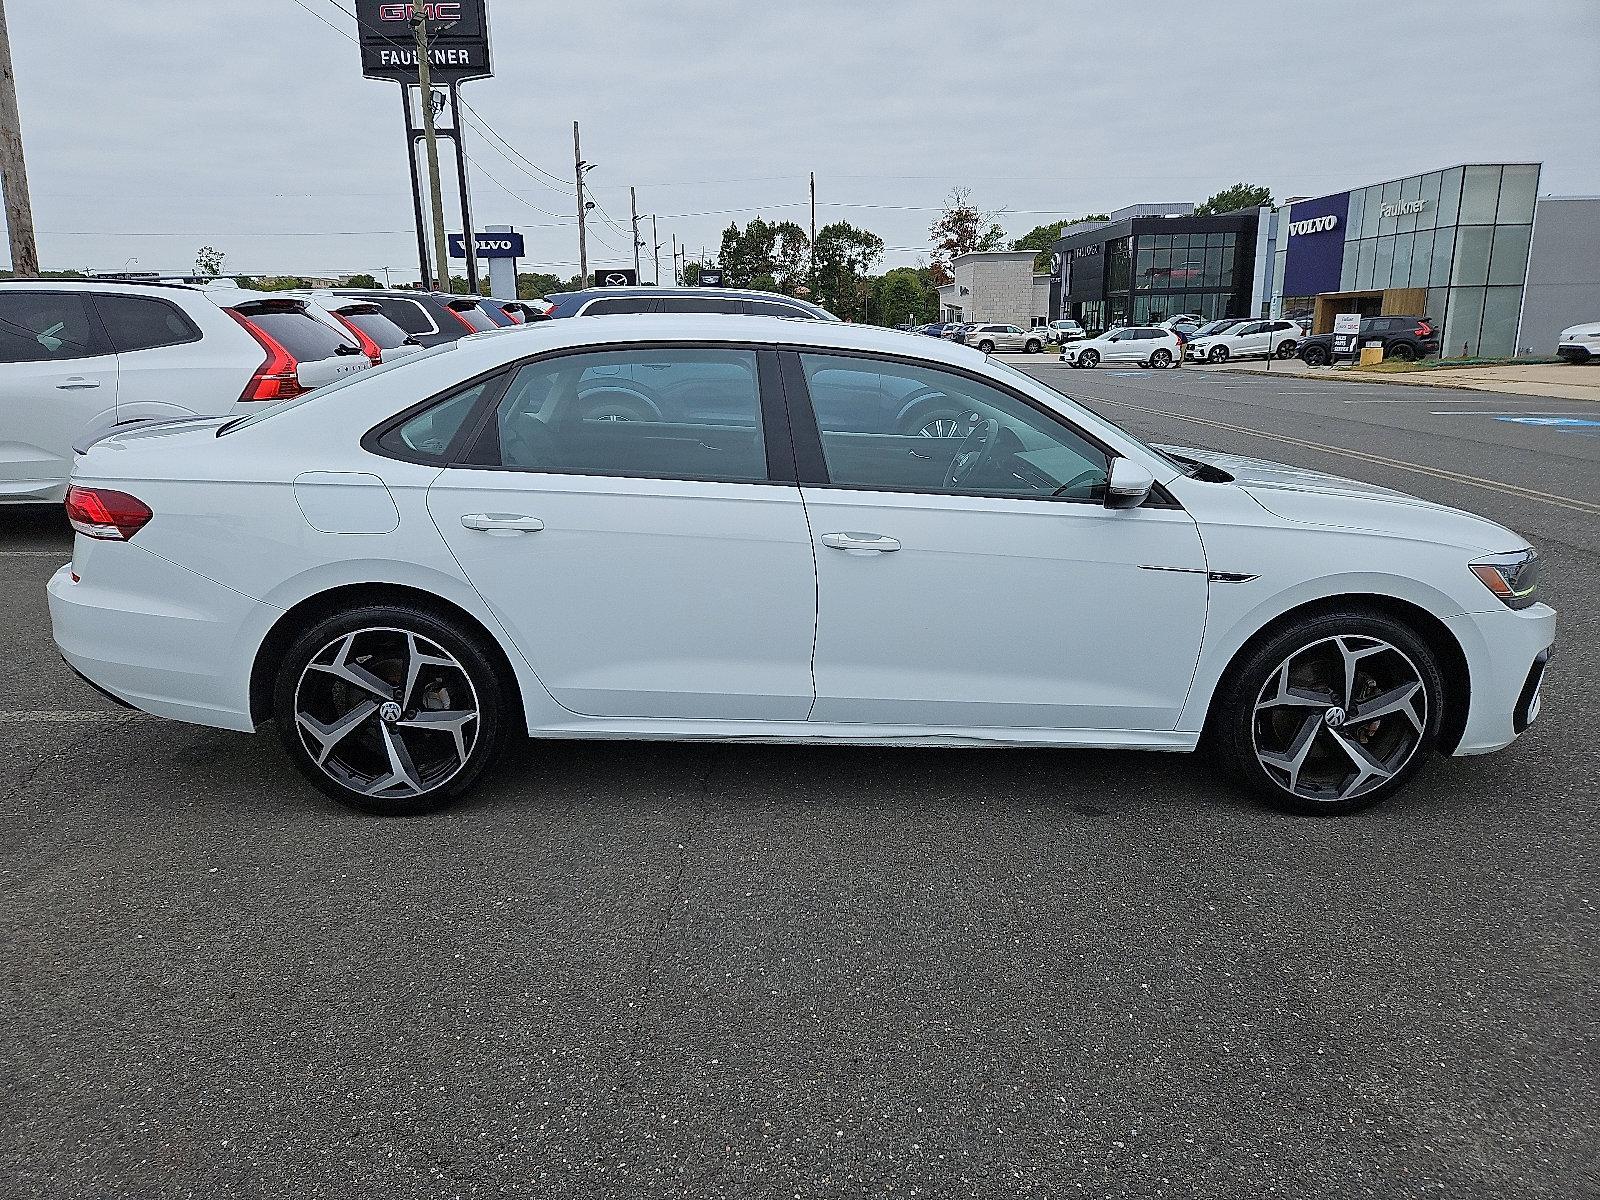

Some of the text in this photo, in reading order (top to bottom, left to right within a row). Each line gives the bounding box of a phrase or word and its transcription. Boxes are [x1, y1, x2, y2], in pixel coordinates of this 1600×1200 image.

[380, 3, 461, 20] GMC
[380, 49, 470, 65] FAULKNER
[1381, 200, 1427, 219] Faulkner
[1289, 215, 1337, 236] VOLVO
